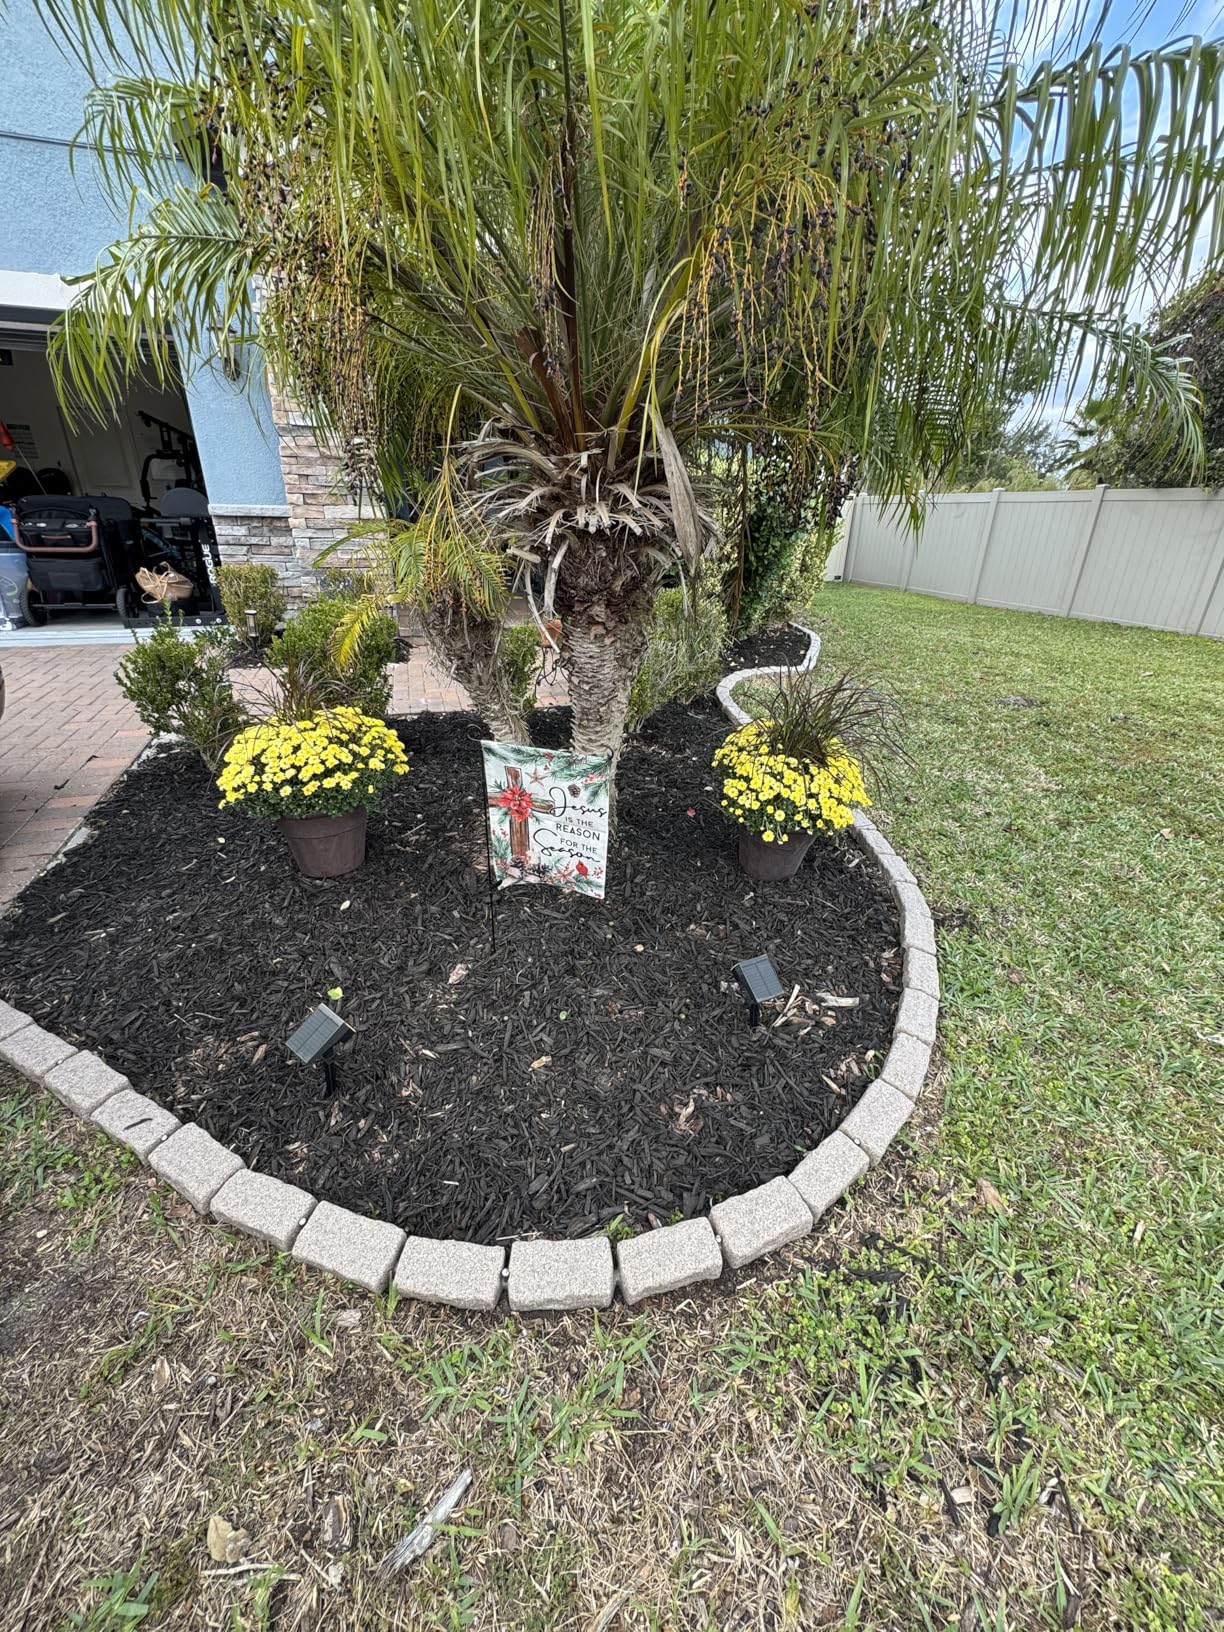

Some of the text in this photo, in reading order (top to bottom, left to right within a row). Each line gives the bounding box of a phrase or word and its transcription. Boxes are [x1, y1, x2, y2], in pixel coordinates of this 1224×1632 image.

[201, 544, 217, 584] ROGUE
[549, 786, 607, 817] Jesus
[556, 823, 600, 841] REASON
[576, 818, 594, 828] THE
[533, 828, 600, 863] Season
[560, 838, 598, 855] FOR THE
